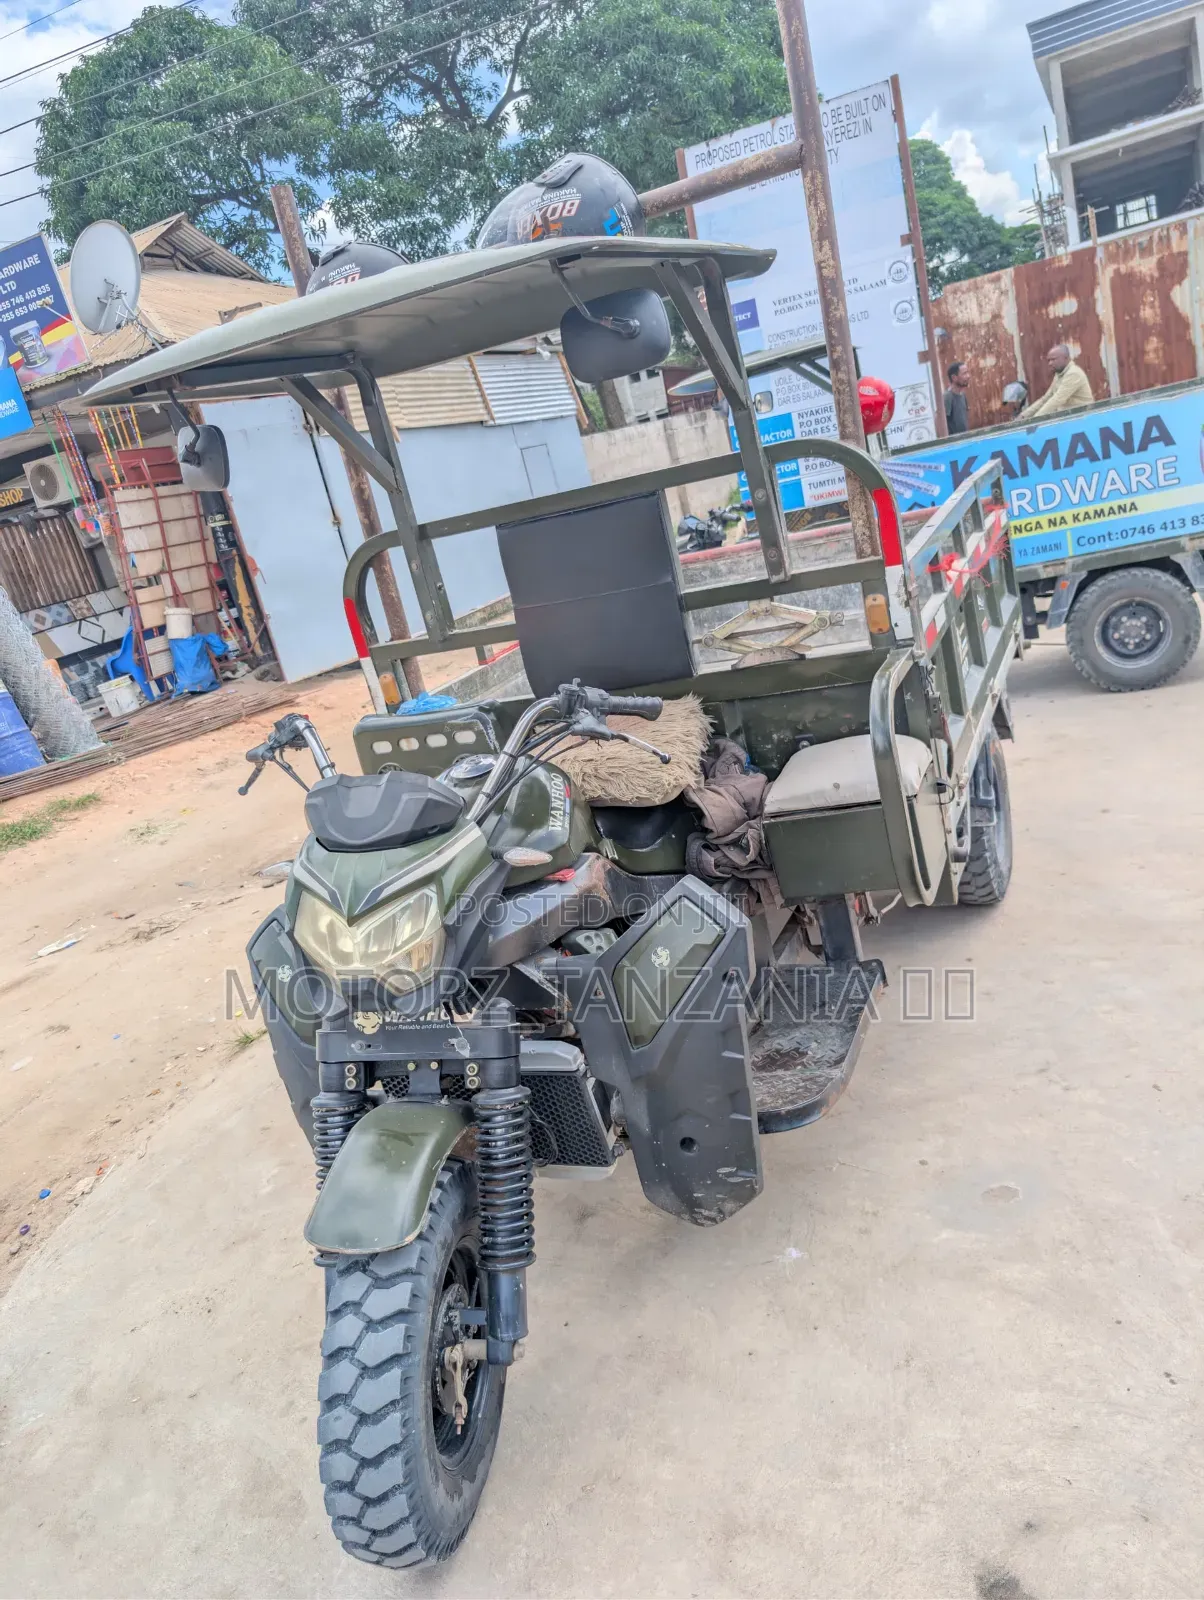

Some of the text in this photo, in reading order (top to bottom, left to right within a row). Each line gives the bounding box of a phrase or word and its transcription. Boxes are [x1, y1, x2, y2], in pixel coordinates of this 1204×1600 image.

[694, 140, 741, 170] PROPOSED
[743, 127, 778, 154] PETROL
[779, 124, 796, 143] STA
[830, 106, 844, 125] BE
[844, 97, 870, 120] BUILT
[872, 92, 887, 112] ON
[862, 117, 873, 136] IN
[0, 280, 17, 295] LTD
[854, 279, 887, 293] SALAAM
[10, 294, 25, 306] 746
[25, 290, 37, 300] 413
[36, 284, 51, 295] 835
[772, 293, 804, 307] VERTEX
[14, 305, 28, 317] 653
[767, 323, 818, 344] CONSTRUCTION
[856, 310, 870, 322] LTD
[777, 397, 792, 407] DAR
[797, 405, 835, 420] NYAKIRE
[814, 415, 832, 425] BOX
[800, 427, 819, 438] DAR
[820, 425, 831, 434] ES
[950, 414, 1177, 491] KAMANA
[1006, 455, 1181, 518] RDWARE
[0, 487, 24, 507] SHOP
[1010, 501, 1138, 536] NGA NA KAMANA
[1159, 517, 1187, 533] 413
[1030, 541, 1062, 556] ZAMANI
[549, 772, 564, 831] WANHOO
